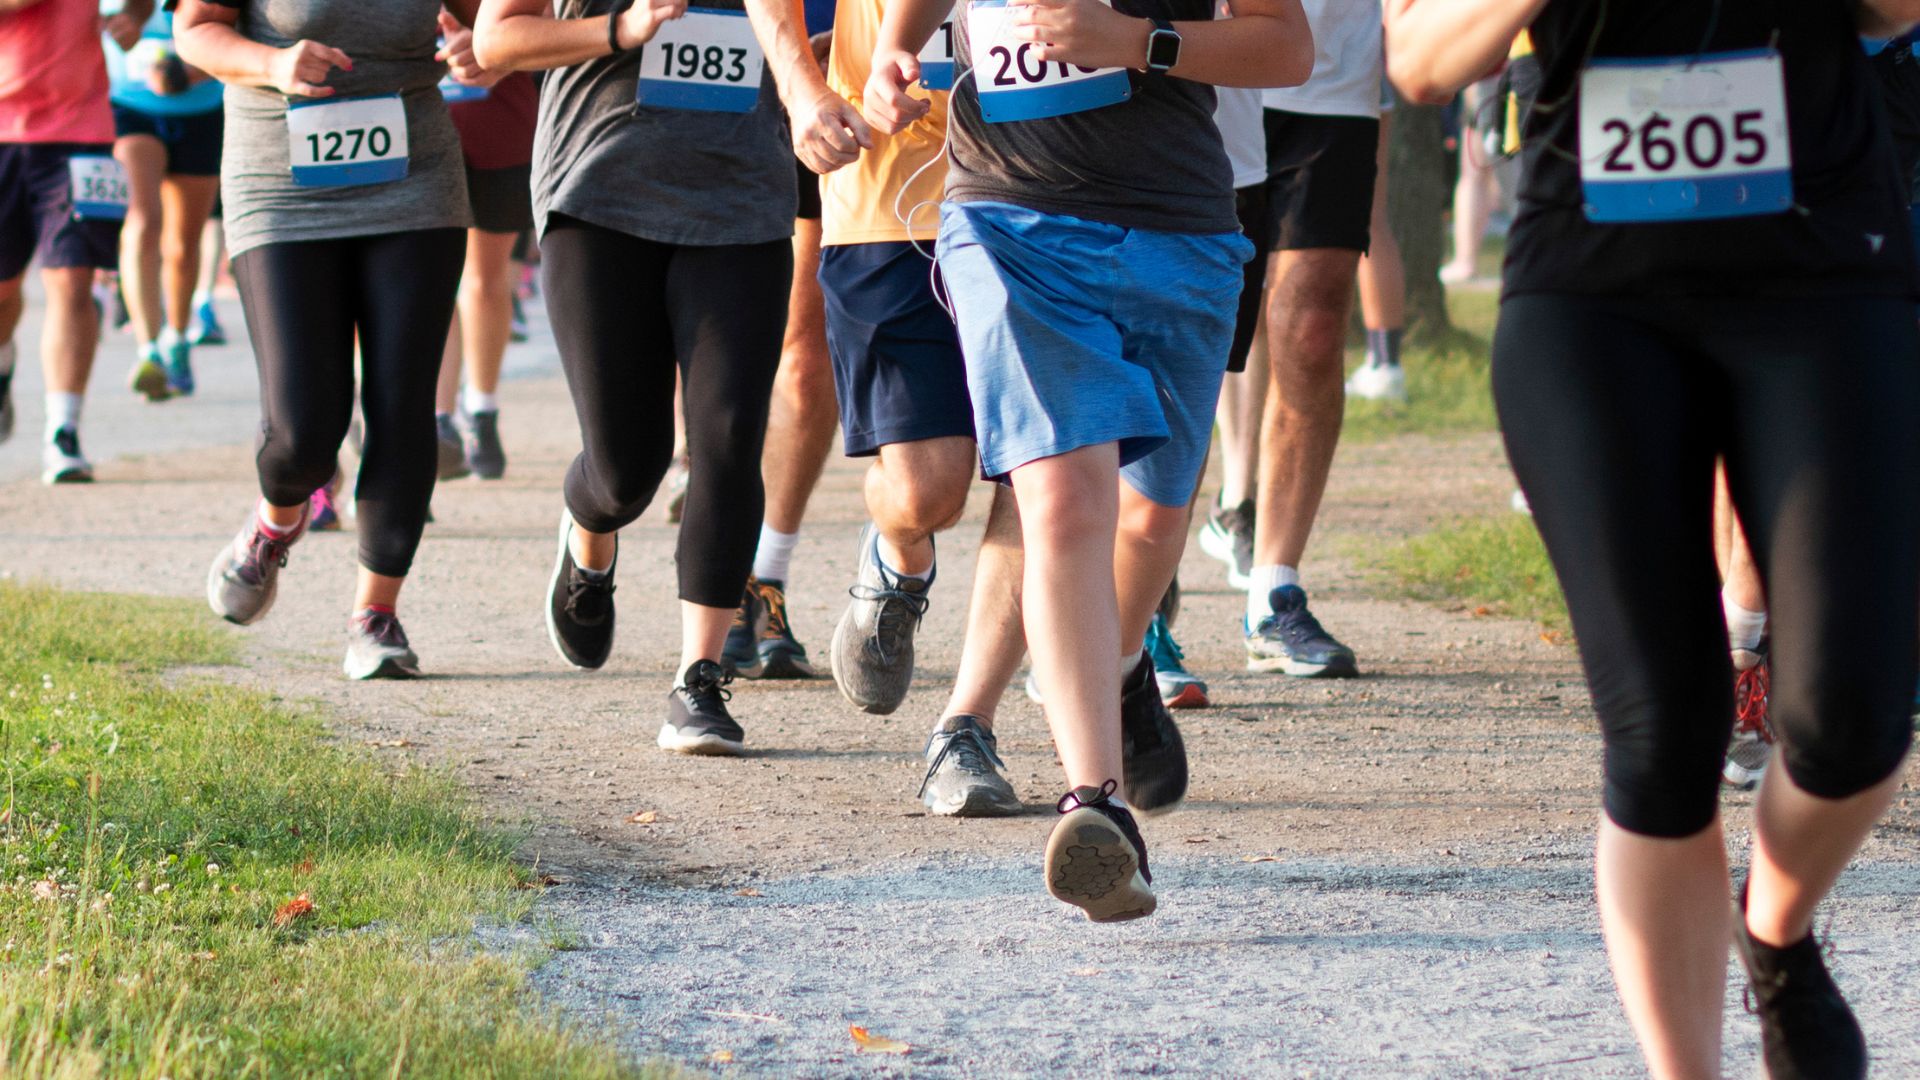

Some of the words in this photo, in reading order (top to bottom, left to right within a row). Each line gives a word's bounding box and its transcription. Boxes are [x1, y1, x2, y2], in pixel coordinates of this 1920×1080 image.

[661, 42, 747, 82] 1983
[989, 42, 1100, 86] 201
[306, 126, 391, 162] 1270
[1602, 111, 1767, 172] 2605
